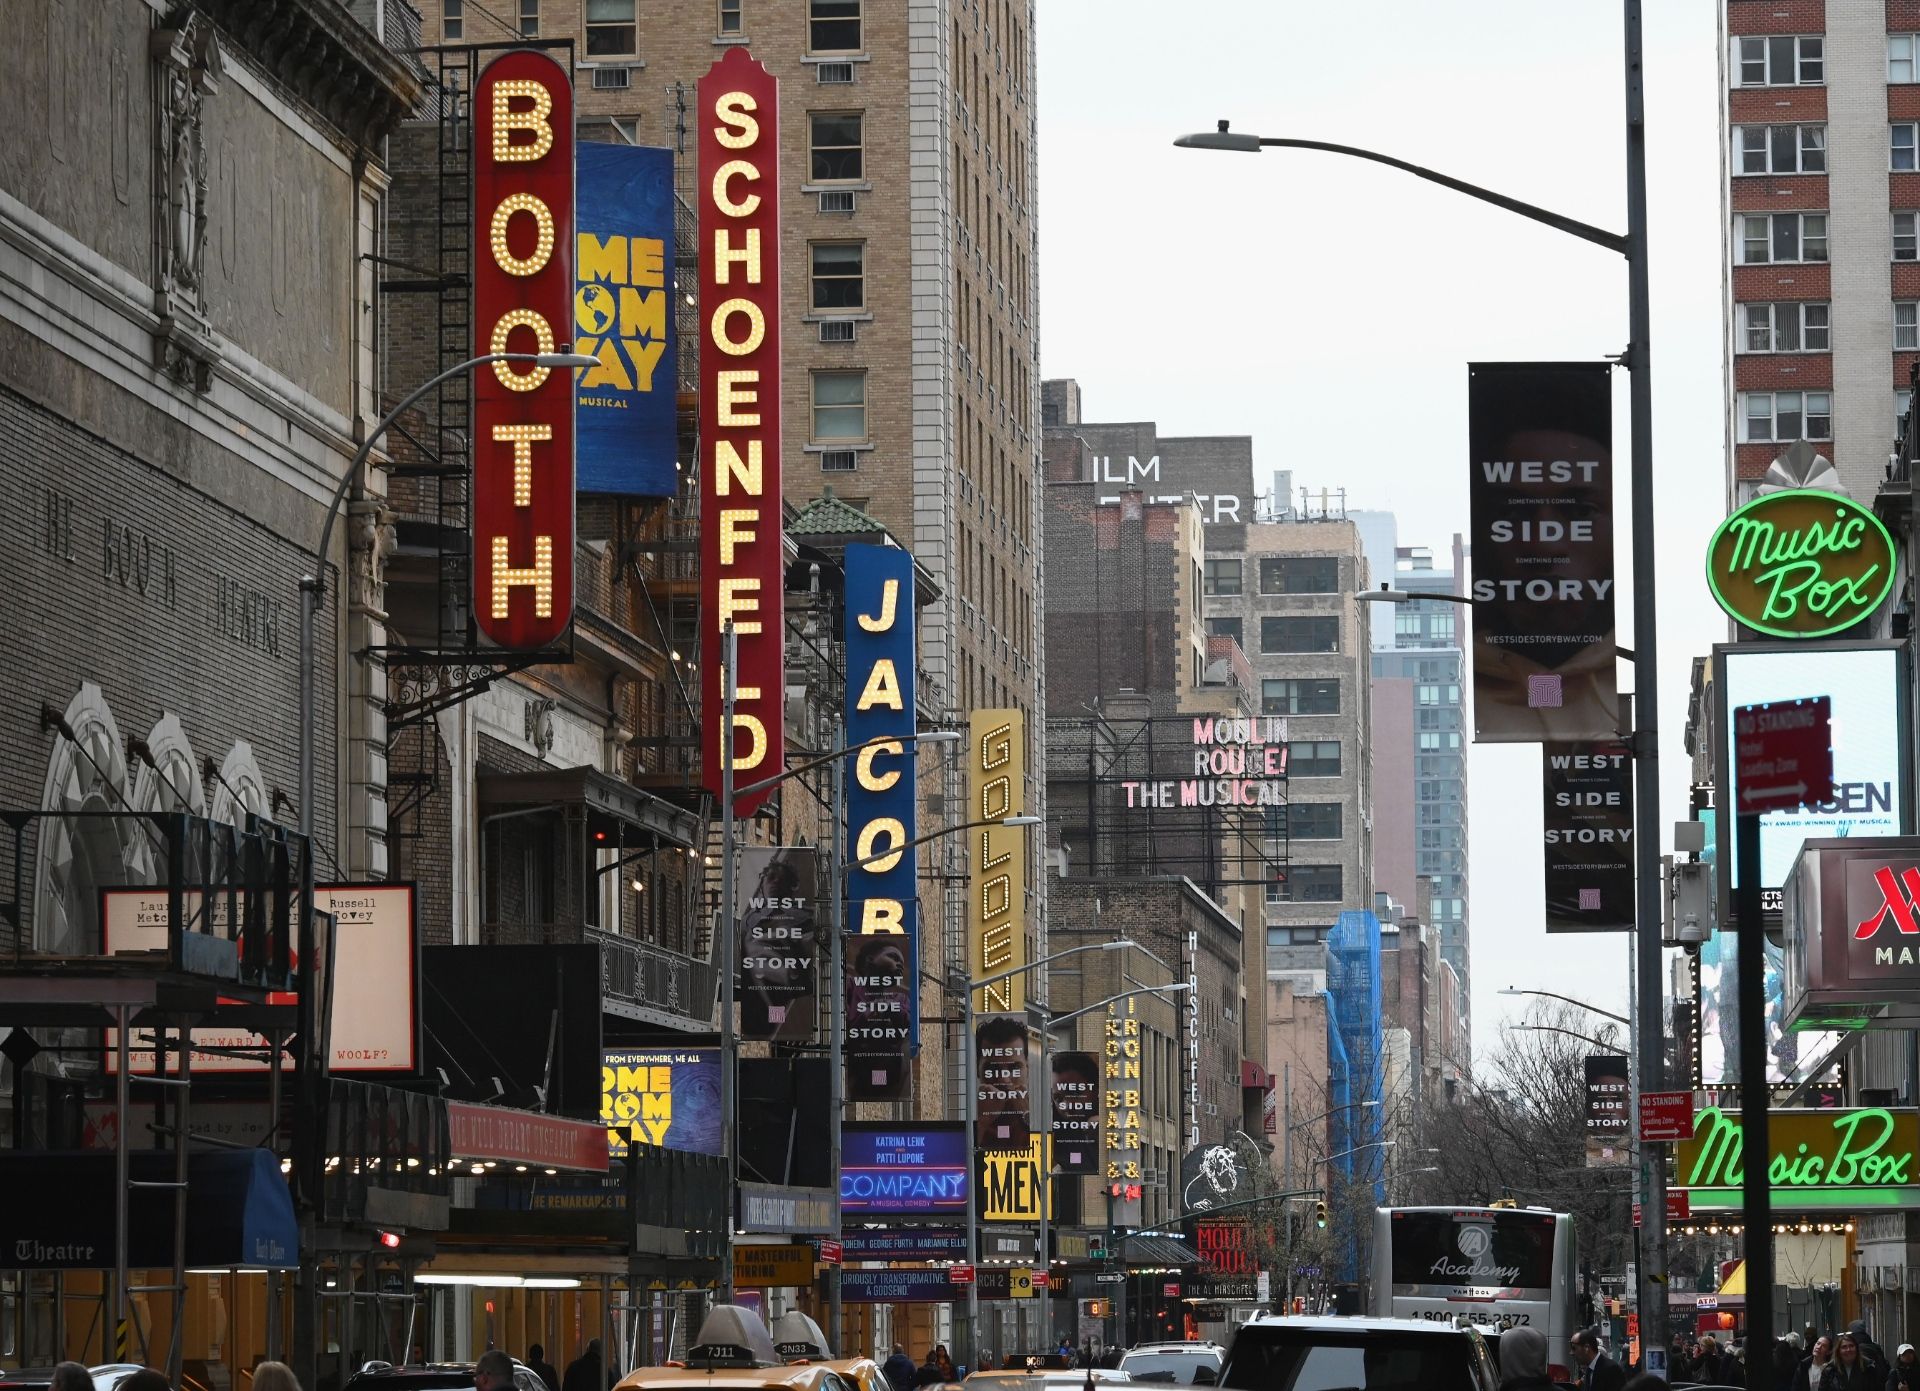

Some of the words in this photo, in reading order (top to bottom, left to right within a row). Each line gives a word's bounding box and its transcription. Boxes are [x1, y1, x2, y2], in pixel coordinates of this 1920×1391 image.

[490, 80, 554, 619] BOOTH
[579, 397, 628, 408] MUSICAL
[1482, 461, 1599, 483] WEST
[1490, 520, 1593, 543] SIDE
[1729, 508, 1865, 573] Music
[104, 515, 176, 611] BOOH
[1473, 579, 1613, 602] STORY
[1754, 560, 1879, 621] Box
[1485, 635, 1603, 644] WESTSIDESTORYBWAY.COM
[1739, 715, 1756, 734] NO
[1758, 708, 1816, 733] STANDING
[1193, 717, 1288, 745] MOULIN
[856, 579, 905, 934] JACOB
[1194, 748, 1288, 776] ROUGE!
[1551, 755, 1624, 769] WEST
[1121, 781, 1175, 808] THE
[1180, 779, 1288, 807] MUSICAL
[1556, 792, 1620, 806] SIDE
[1545, 828, 1633, 843] STORY
[981, 723, 1012, 1013] GOLDEN
[330, 898, 376, 908] Russell
[748, 897, 806, 909] WEST
[332, 911, 373, 921] Tovey
[752, 927, 803, 939] SIDE
[1875, 946, 1920, 965] MA
[742, 957, 811, 969] STORY
[854, 976, 903, 987] WEST
[857, 1002, 901, 1013] SIDE
[849, 1027, 909, 1039] STORY
[1124, 997, 1140, 1079] IRON
[1188, 930, 1200, 1146] HIRSCHFELD
[200, 1037, 253, 1046] EDWARD
[337, 1050, 389, 1061] WOOLF?
[981, 1047, 1023, 1057] WEST
[605, 1055, 626, 1064] FROM
[627, 1055, 674, 1064] EVERYWHERE,
[675, 1055, 686, 1063] WE
[687, 1055, 700, 1063] ALL
[984, 1069, 1021, 1078] SIDE
[1056, 1083, 1095, 1091] WEST
[1590, 1084, 1625, 1092] WEST
[978, 1090, 1029, 1100] STORY
[1641, 1097, 1651, 1106] NO
[1652, 1096, 1684, 1106] STANDING
[1058, 1102, 1093, 1110] SIDE
[1053, 1121, 1099, 1130] STORY
[1106, 1090, 1121, 1149] BAR
[1125, 1090, 1141, 1149] BAR
[1586, 1119, 1629, 1127] STORY
[1641, 1117, 1662, 1126] Loading
[1662, 1116, 1675, 1124] Zone
[875, 1136, 906, 1147] KATRINA
[907, 1136, 925, 1147] LENK
[1688, 1105, 1825, 1186] Msic
[1825, 1107, 1912, 1185] Box
[876, 1153, 896, 1164] PATTI
[897, 1153, 925, 1163] LUPONE
[1125, 1161, 1140, 1178] &
[840, 1173, 966, 1197] COMPANY
[984, 1160, 1042, 1213] MEN
[841, 1239, 865, 1249] NDHEIM
[869, 1239, 893, 1249] GEORGE
[893, 1239, 914, 1248] FURTH
[917, 1239, 949, 1248] MARIANNE
[950, 1239, 967, 1248] ELLIO
[16, 1240, 95, 1263] Theatre
[1430, 1256, 1521, 1284] Academy
[1092, 1304, 1098, 1314] 8
[708, 1347, 735, 1358] 7J11
[782, 1345, 807, 1354] 3N33
